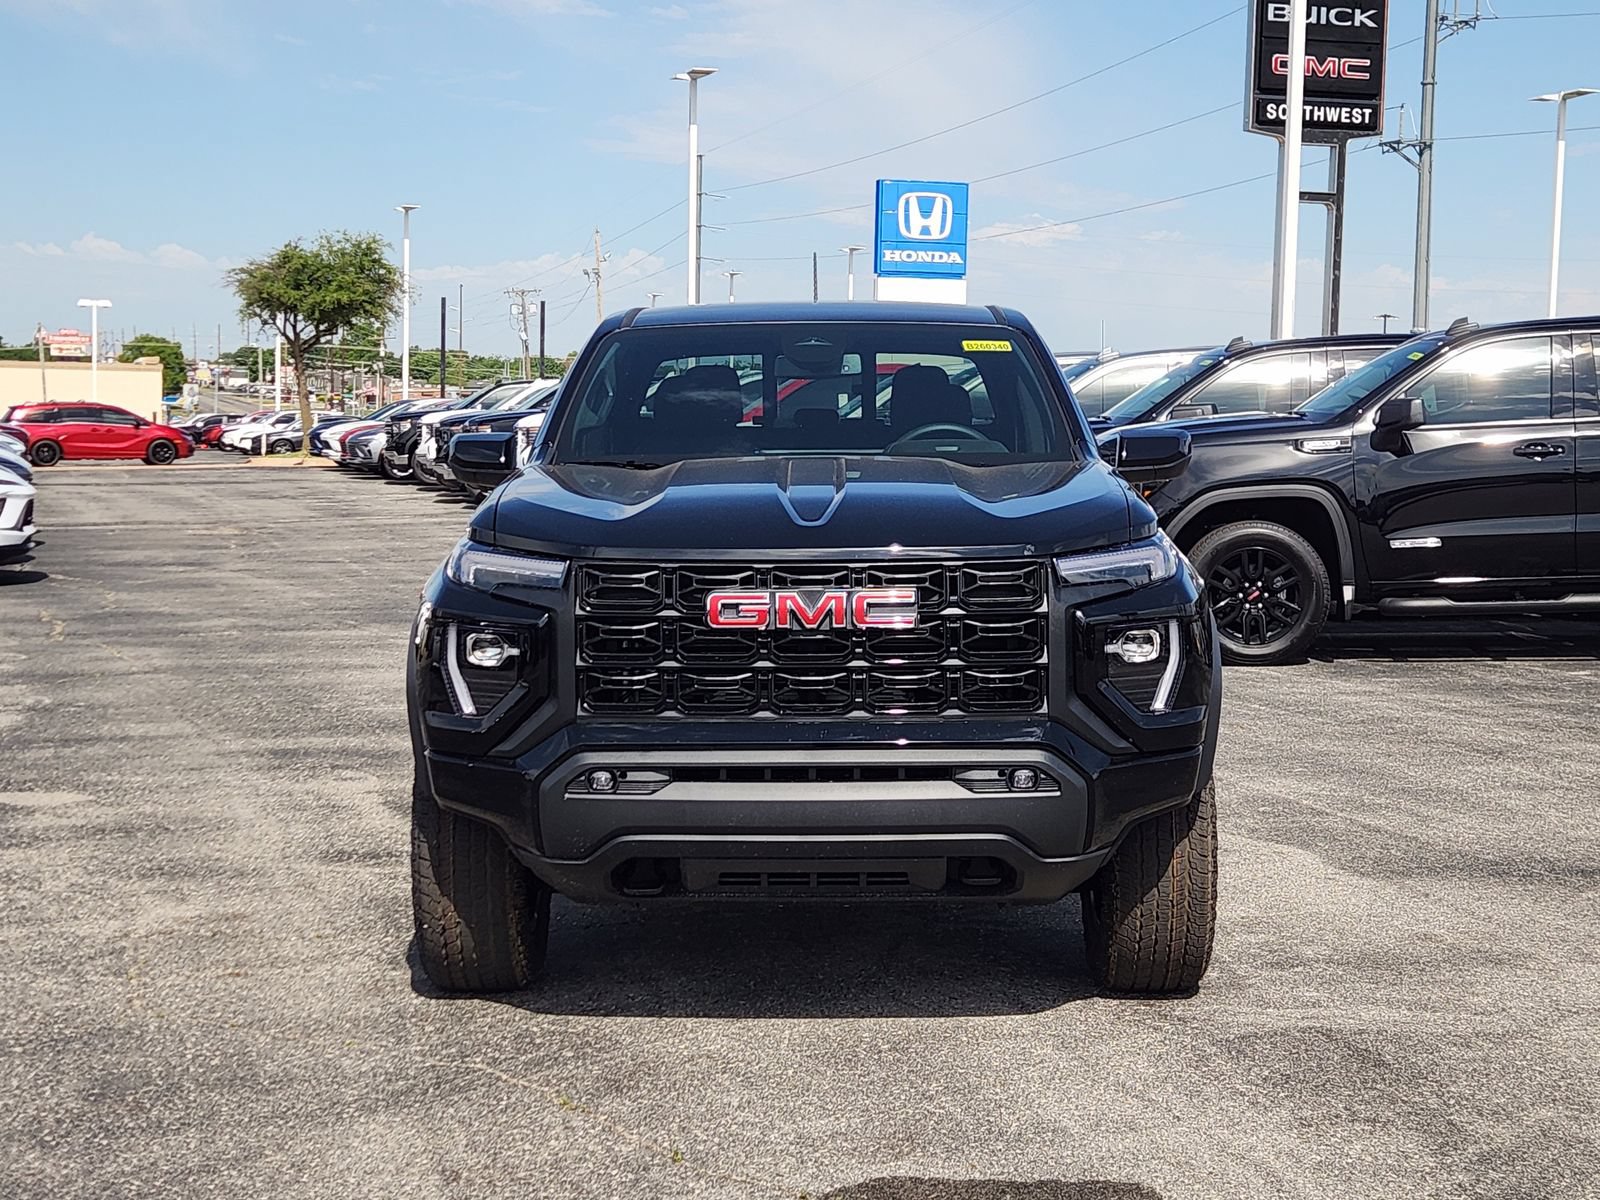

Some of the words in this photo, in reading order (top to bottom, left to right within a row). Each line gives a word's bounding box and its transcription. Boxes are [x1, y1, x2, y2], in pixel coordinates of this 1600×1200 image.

[1266, 103, 1373, 124] SOTHWEST
[883, 249, 964, 264] HONDA
[965, 342, 1010, 351] B260340
[706, 590, 918, 629] GMC
